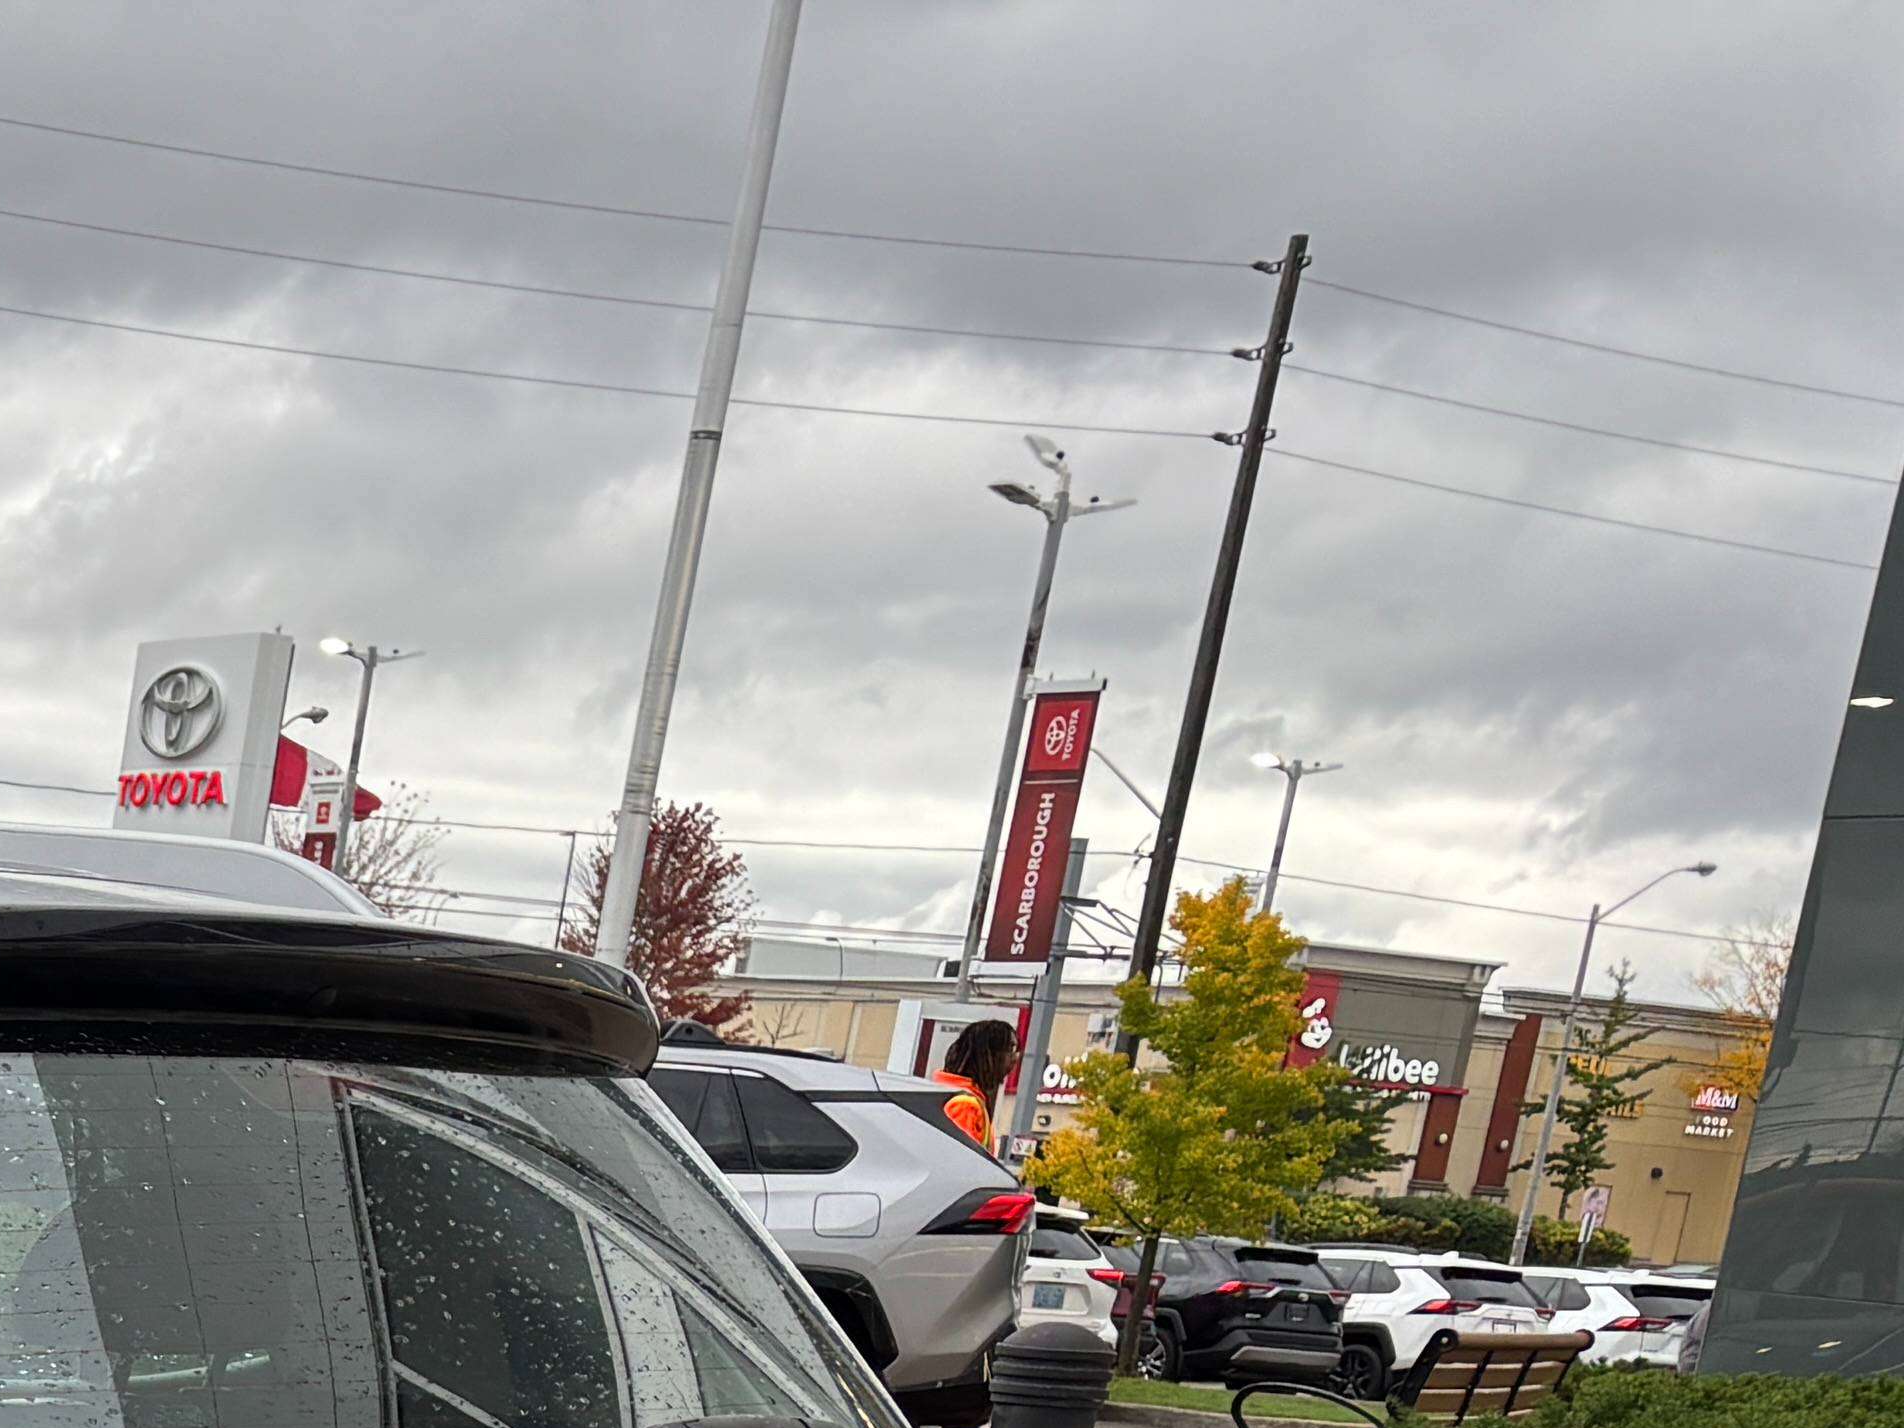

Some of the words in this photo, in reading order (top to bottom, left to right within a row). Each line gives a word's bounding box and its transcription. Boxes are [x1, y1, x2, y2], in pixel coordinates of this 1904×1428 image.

[1062, 708, 1080, 761] TOYOTA
[118, 771, 226, 808] TOYOTA
[1010, 793, 1055, 956] SCARBOROUGH
[1695, 1087, 1738, 1109] M&M
[1684, 1125, 1734, 1139] MARKET
